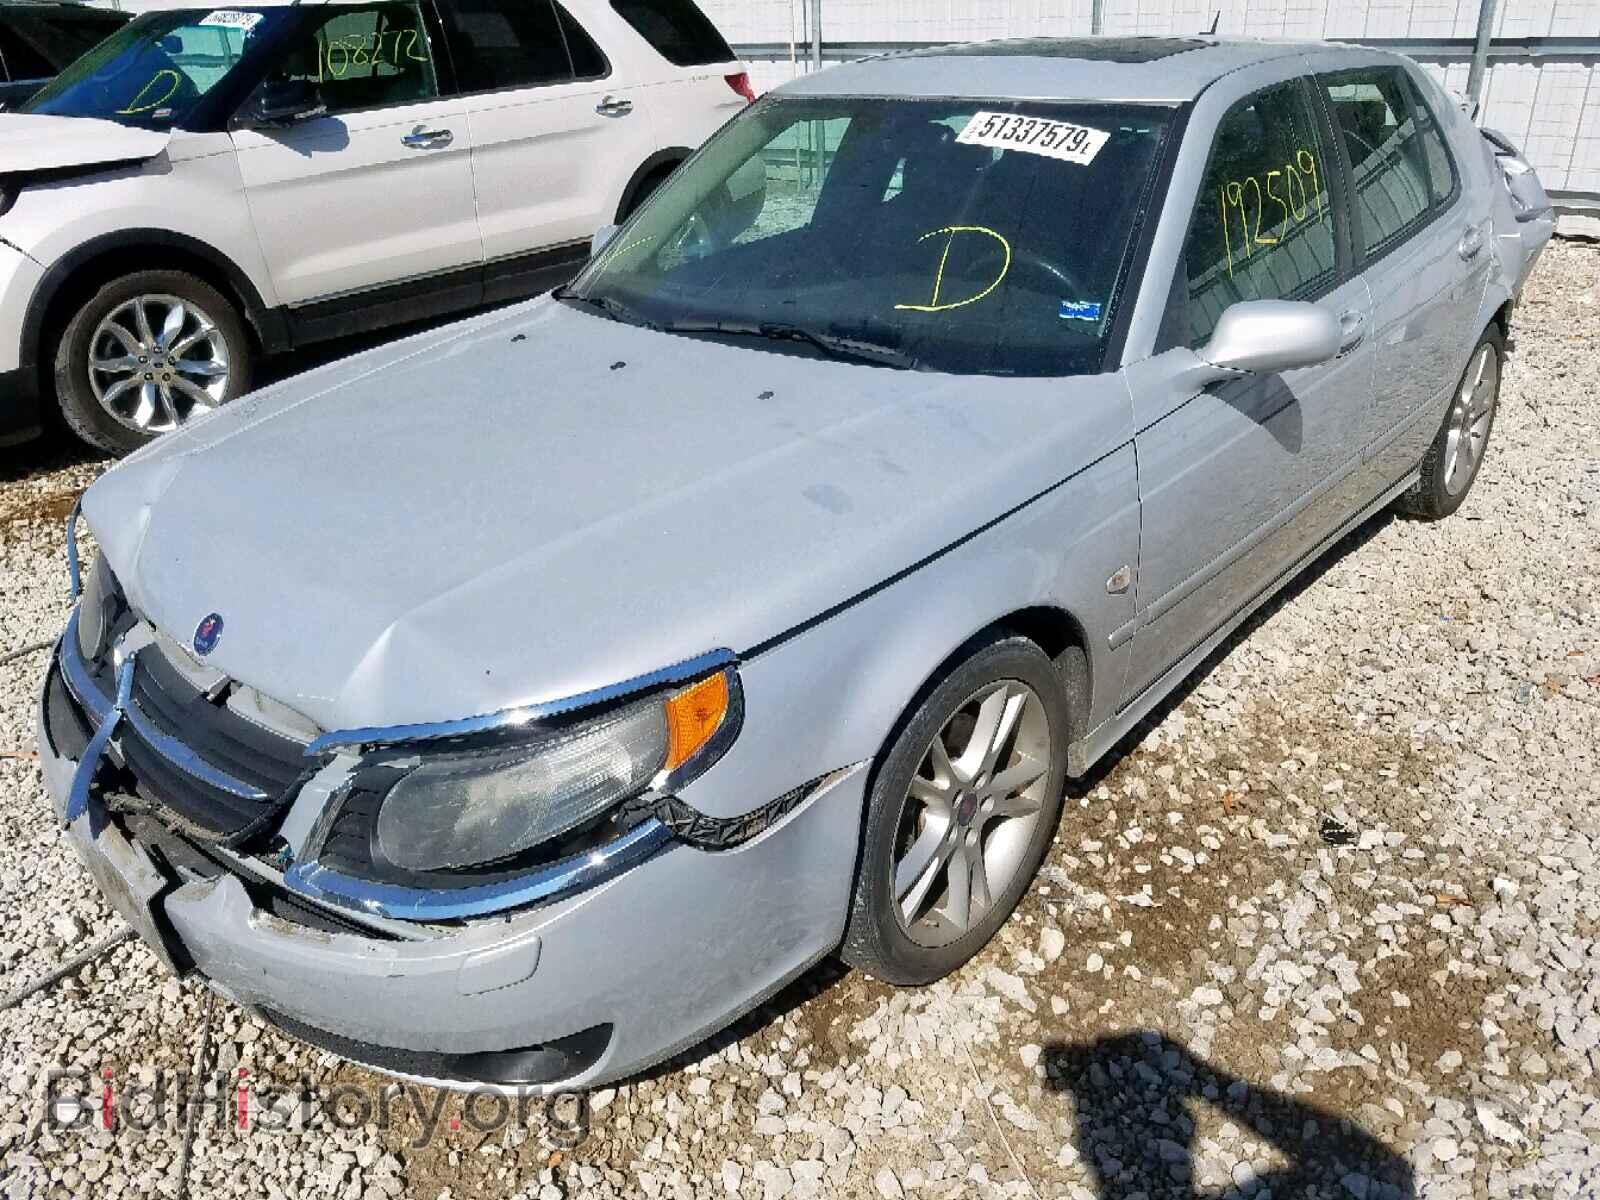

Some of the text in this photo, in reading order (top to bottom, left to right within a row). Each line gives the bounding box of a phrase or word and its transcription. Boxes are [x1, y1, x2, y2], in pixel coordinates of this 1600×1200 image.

[319, 29, 428, 83] 108272
[978, 115, 1088, 152] 51337579
[1220, 150, 1323, 279] 192509
[894, 226, 1011, 311] D
